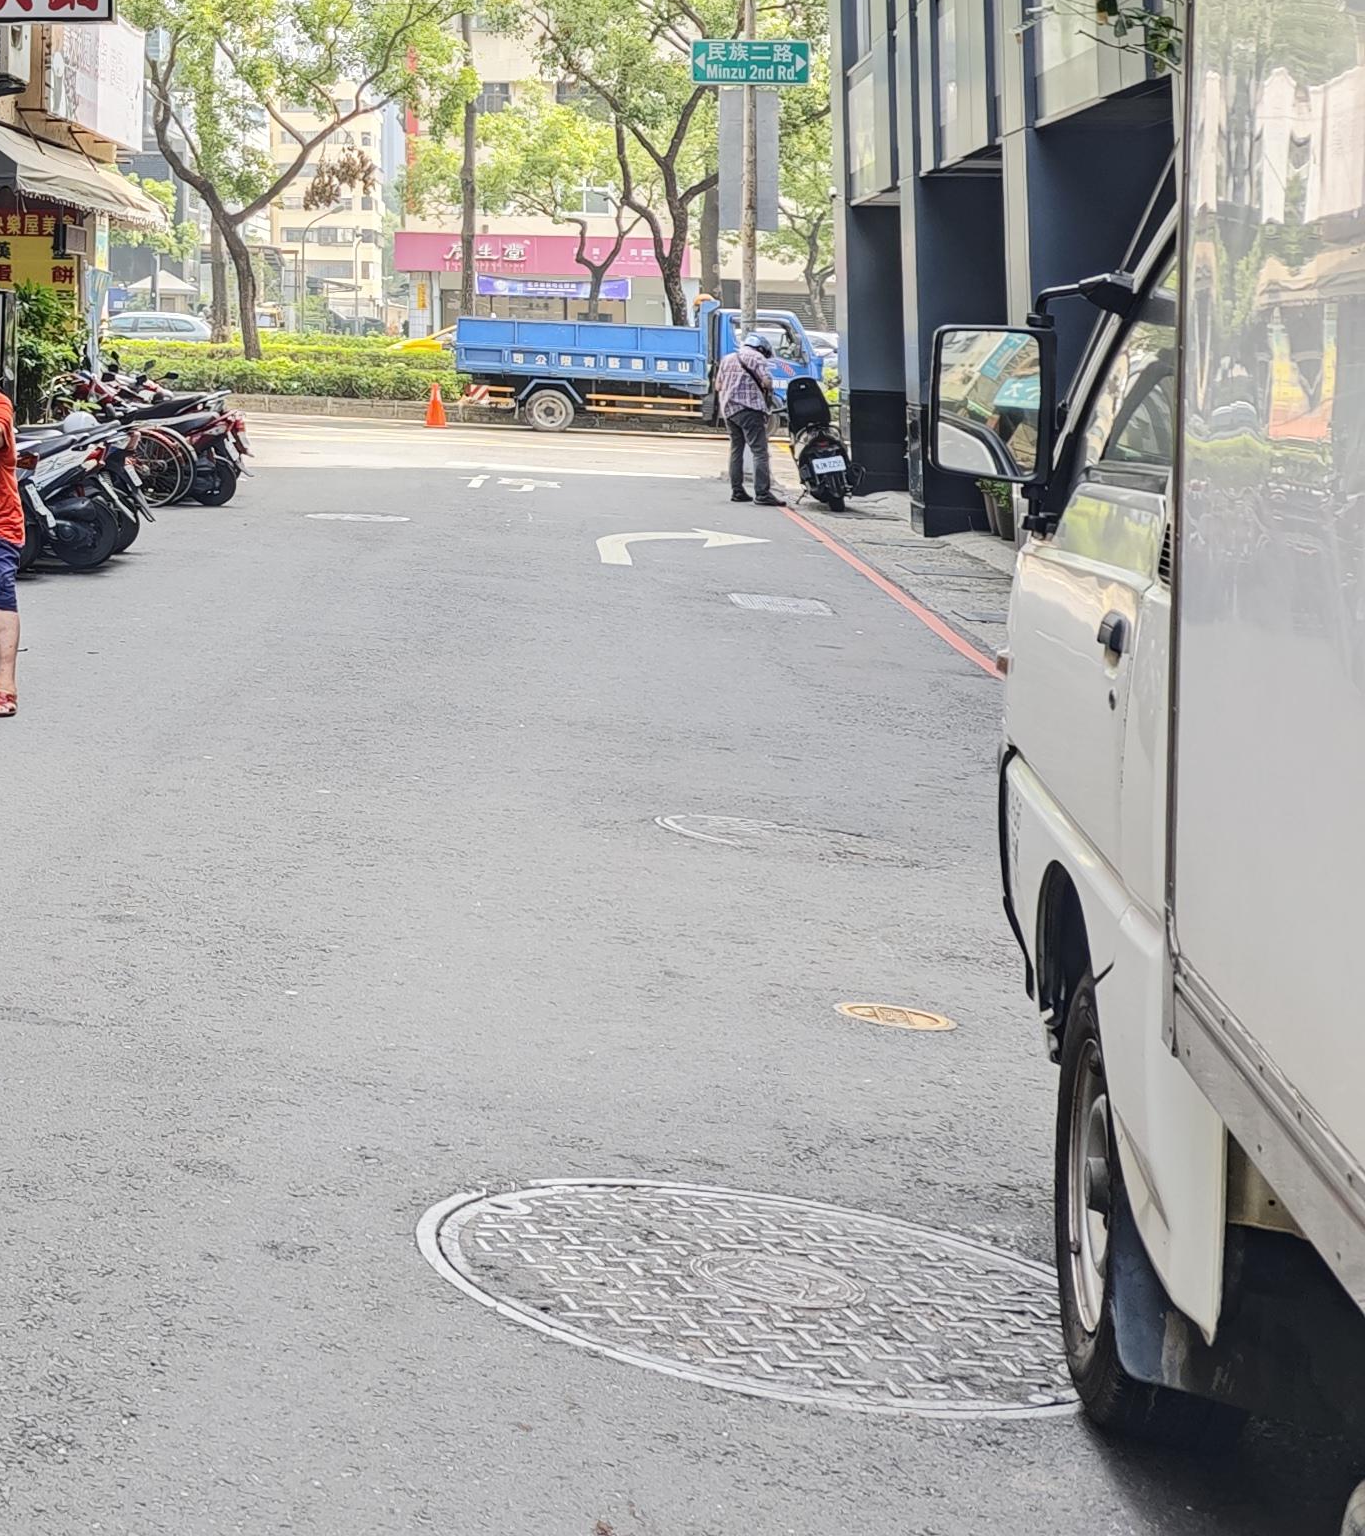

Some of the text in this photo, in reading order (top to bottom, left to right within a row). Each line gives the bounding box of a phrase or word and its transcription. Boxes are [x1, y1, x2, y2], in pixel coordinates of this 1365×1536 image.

[706, 42, 794, 63] 民族二路
[706, 63, 798, 81] Minzu 2nd Rd.
